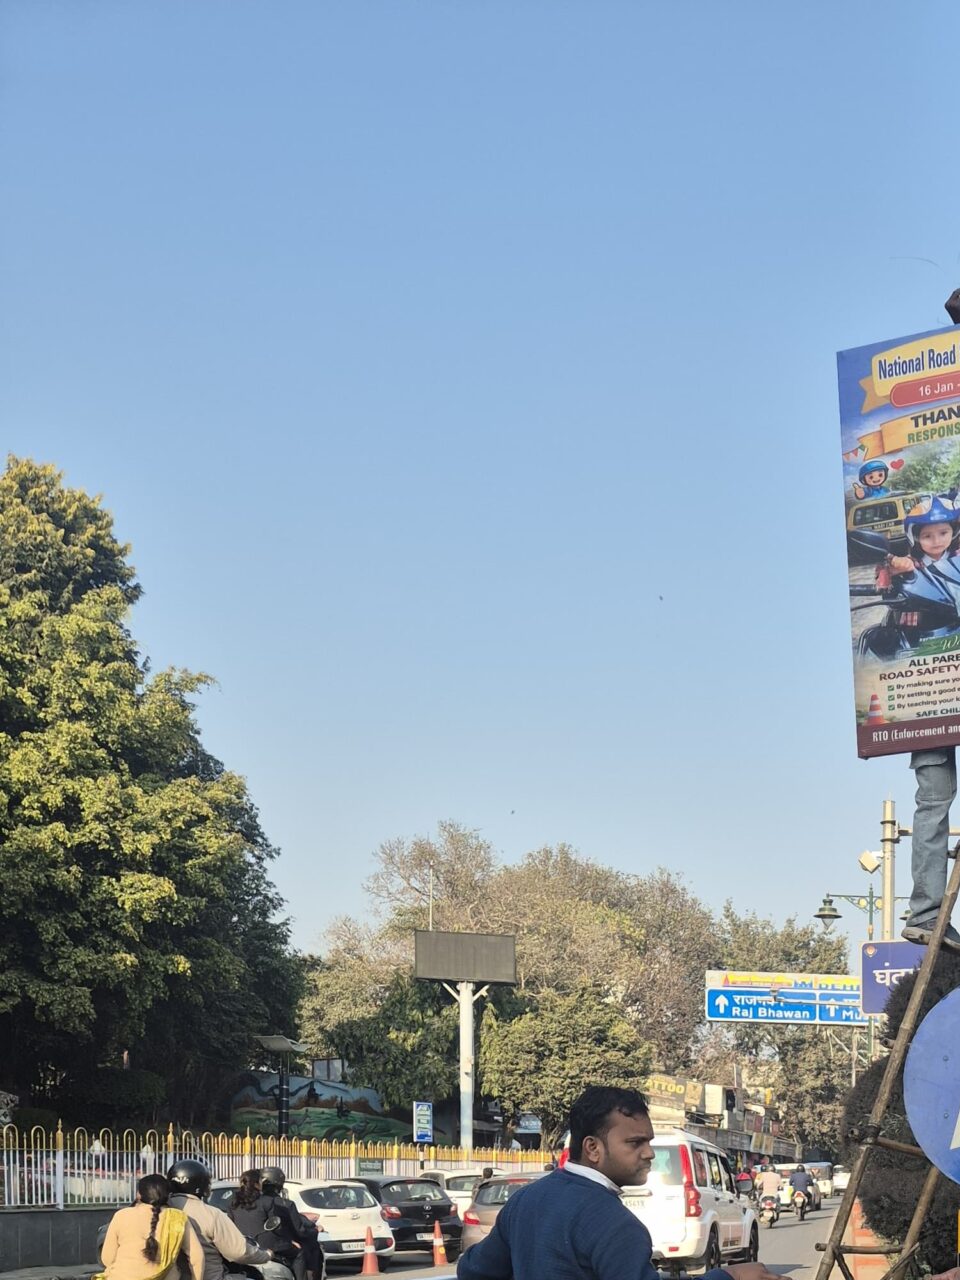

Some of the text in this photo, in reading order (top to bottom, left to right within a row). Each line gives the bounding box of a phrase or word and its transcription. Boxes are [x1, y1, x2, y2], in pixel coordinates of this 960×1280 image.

[878, 351, 924, 380] National
[928, 344, 956, 369] Road
[919, 385, 931, 396] 16
[934, 382, 954, 393] Jan
[940, 637, 959, 650] We
[909, 658, 929, 667] ALL
[879, 670, 913, 681] ROAD
[916, 664, 960, 675] SAFETY
[872, 730, 889, 742] RTO
[891, 723, 946, 741] (Enforcement
[732, 1008, 809, 1019] Raj Bhawan
[645, 1079, 684, 1094] ATTOO
